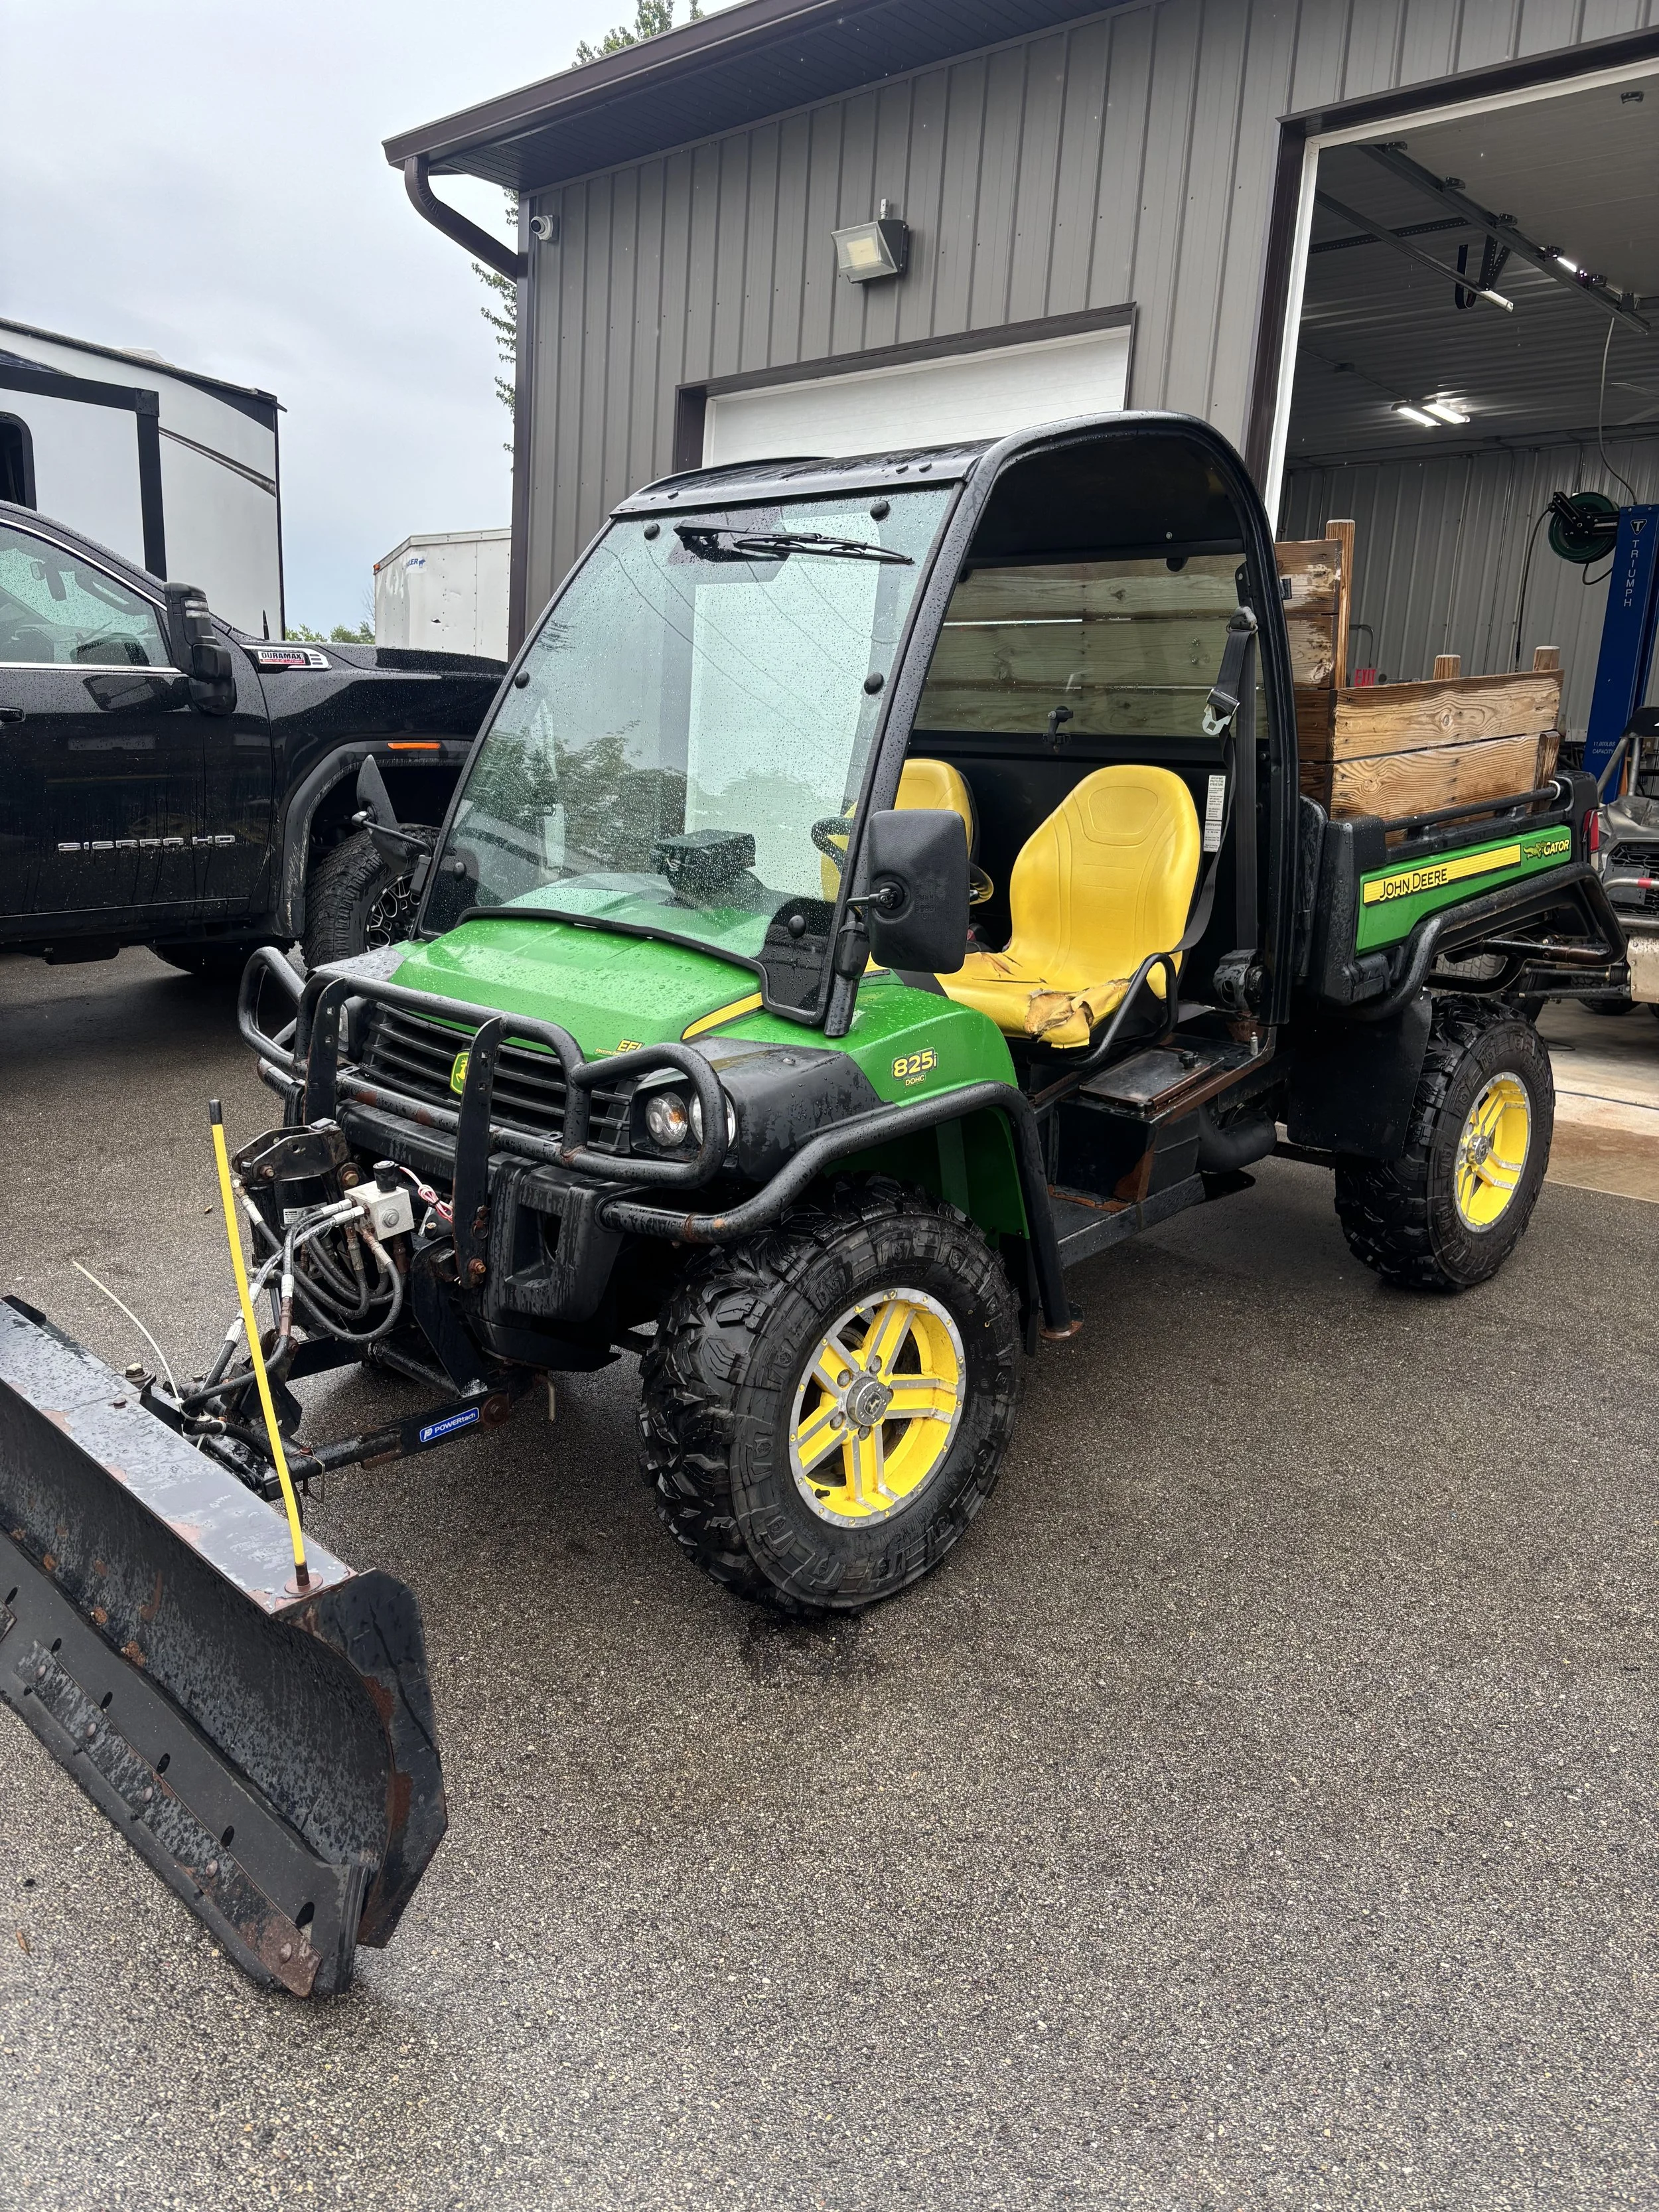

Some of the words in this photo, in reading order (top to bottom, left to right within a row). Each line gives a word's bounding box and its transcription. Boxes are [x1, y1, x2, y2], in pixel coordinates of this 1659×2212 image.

[1623, 540, 1639, 607] TRIUMPH
[1354, 669, 1376, 687] EXIT
[58, 838, 184, 851] SIERRA
[192, 835, 236, 846] HD
[1544, 839, 1570, 857] GATOR
[1380, 877, 1410, 901] JOHN
[1412, 867, 1448, 892] DEERE
[616, 1039, 643, 1053] EFI
[893, 1051, 937, 1078] 825i
[905, 1074, 925, 1086] DOHC
[434, 1412, 476, 1434] POWERtach
